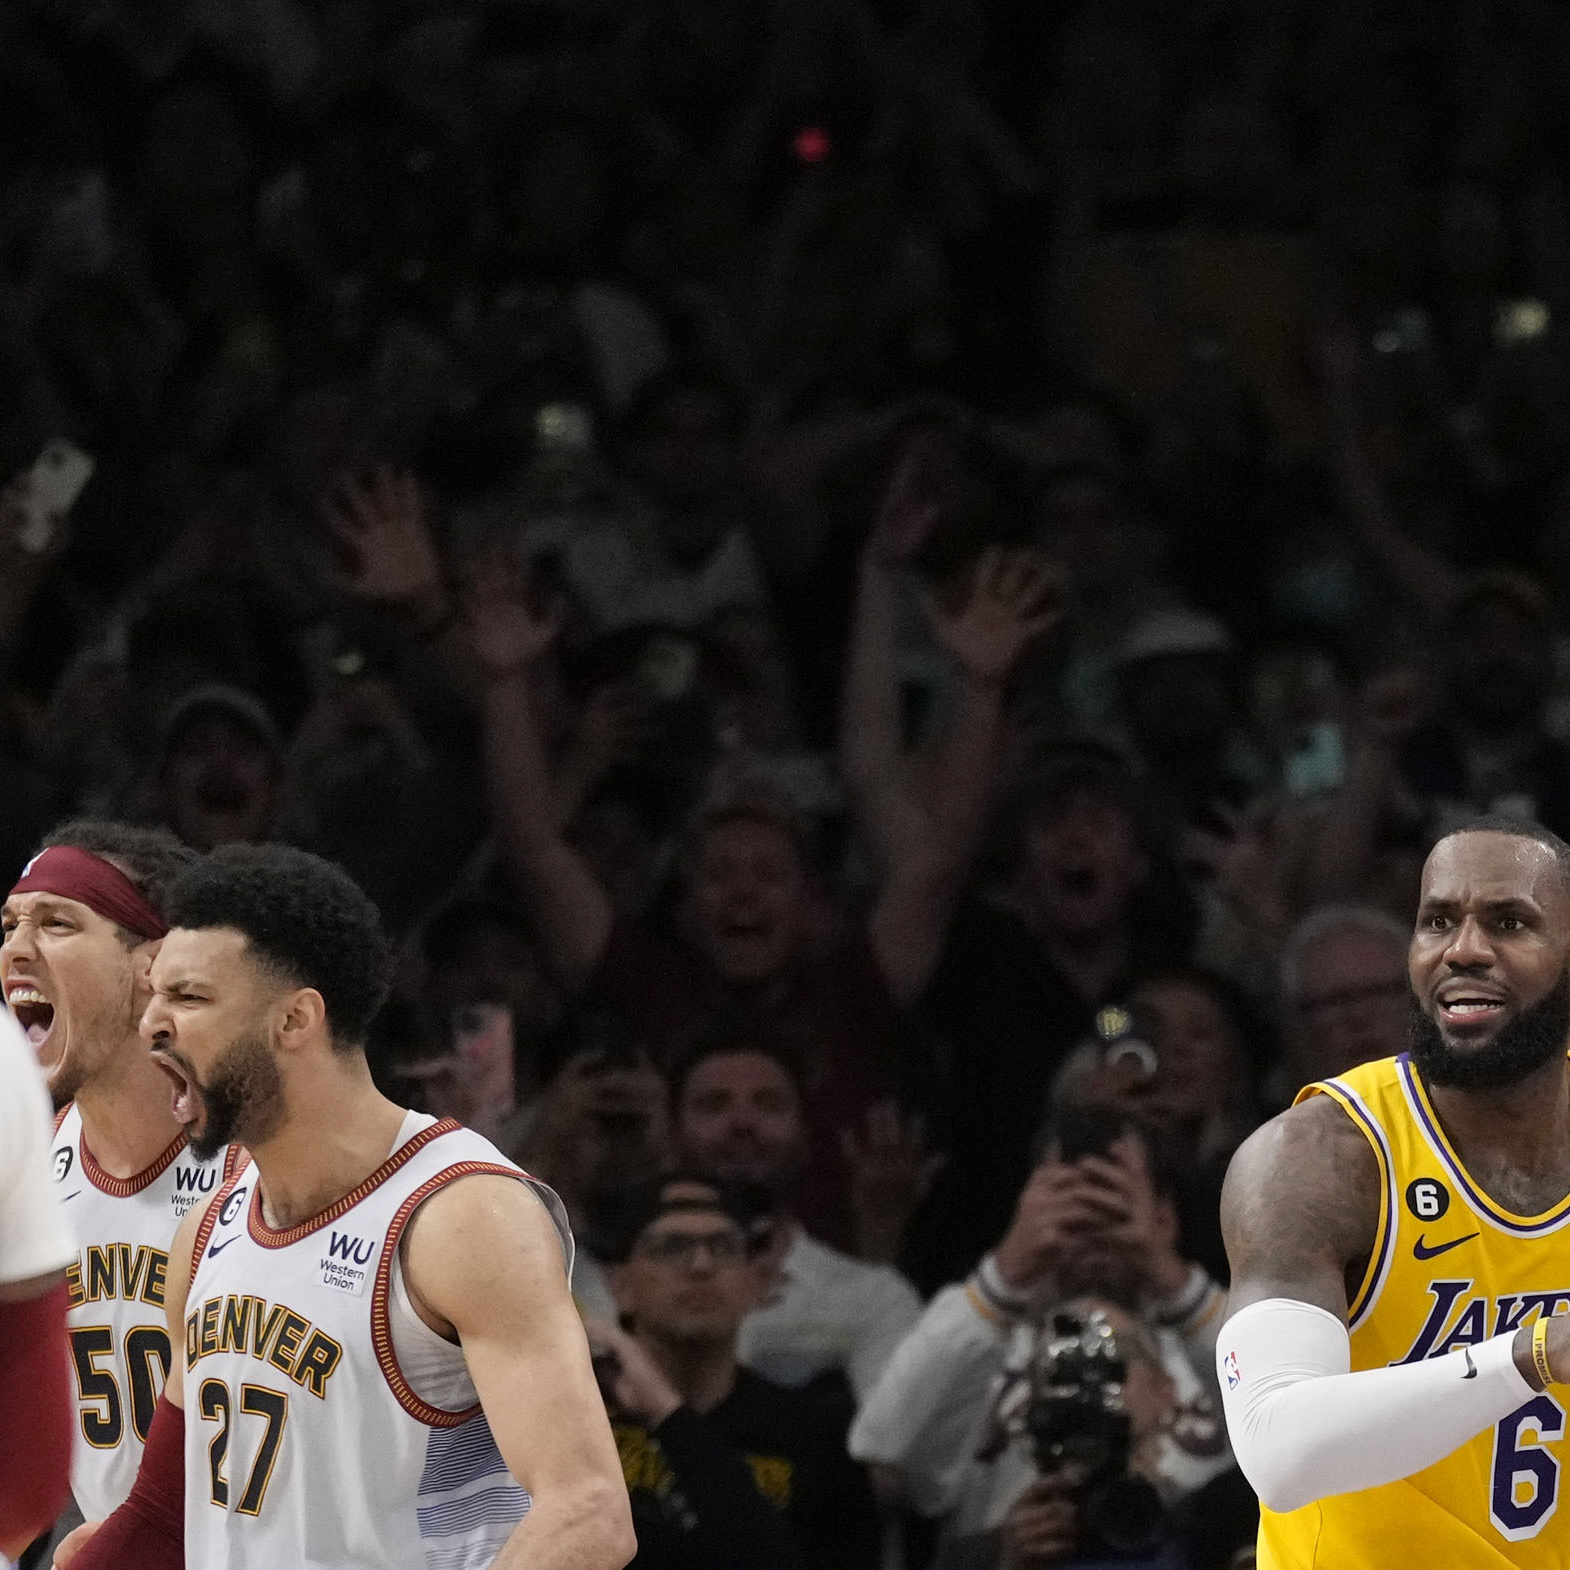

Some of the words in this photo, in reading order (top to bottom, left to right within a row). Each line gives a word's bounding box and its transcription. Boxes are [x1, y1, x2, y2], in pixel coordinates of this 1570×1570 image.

[176, 1167, 217, 1194] WU
[1414, 1184, 1440, 1216] 6
[319, 1258, 365, 1281] Western
[328, 1230, 376, 1266] WU
[66, 1242, 170, 1309] ENVE
[322, 1273, 355, 1292] Union
[185, 1294, 344, 1400] DENVER
[68, 1324, 173, 1449] 50
[198, 1377, 289, 1518] 27
[1488, 1390, 1566, 1542] 6
